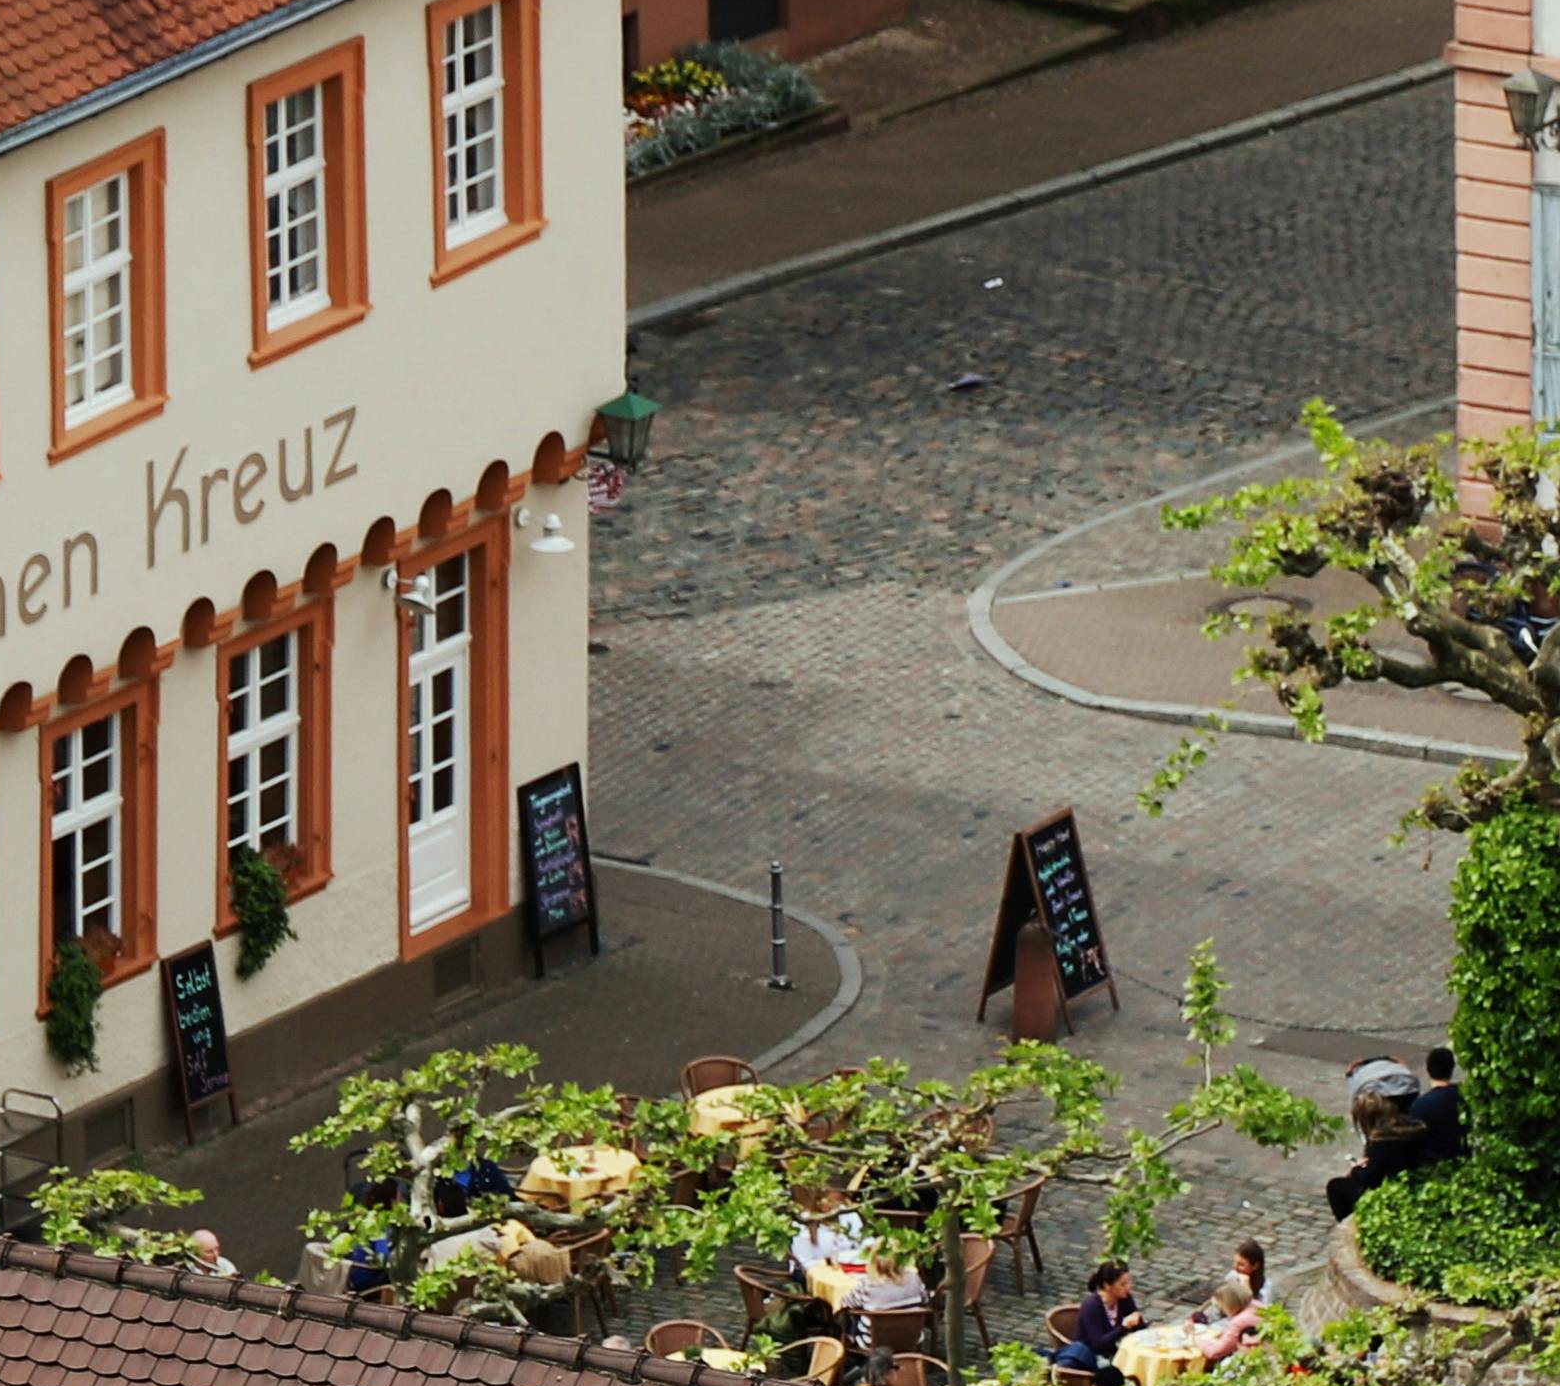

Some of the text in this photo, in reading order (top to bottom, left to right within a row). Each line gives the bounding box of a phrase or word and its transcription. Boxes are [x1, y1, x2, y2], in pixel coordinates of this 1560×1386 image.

[146, 405, 358, 569] Kreuz
[176, 962, 212, 1000] Selbst
[192, 1027, 213, 1049] ung
